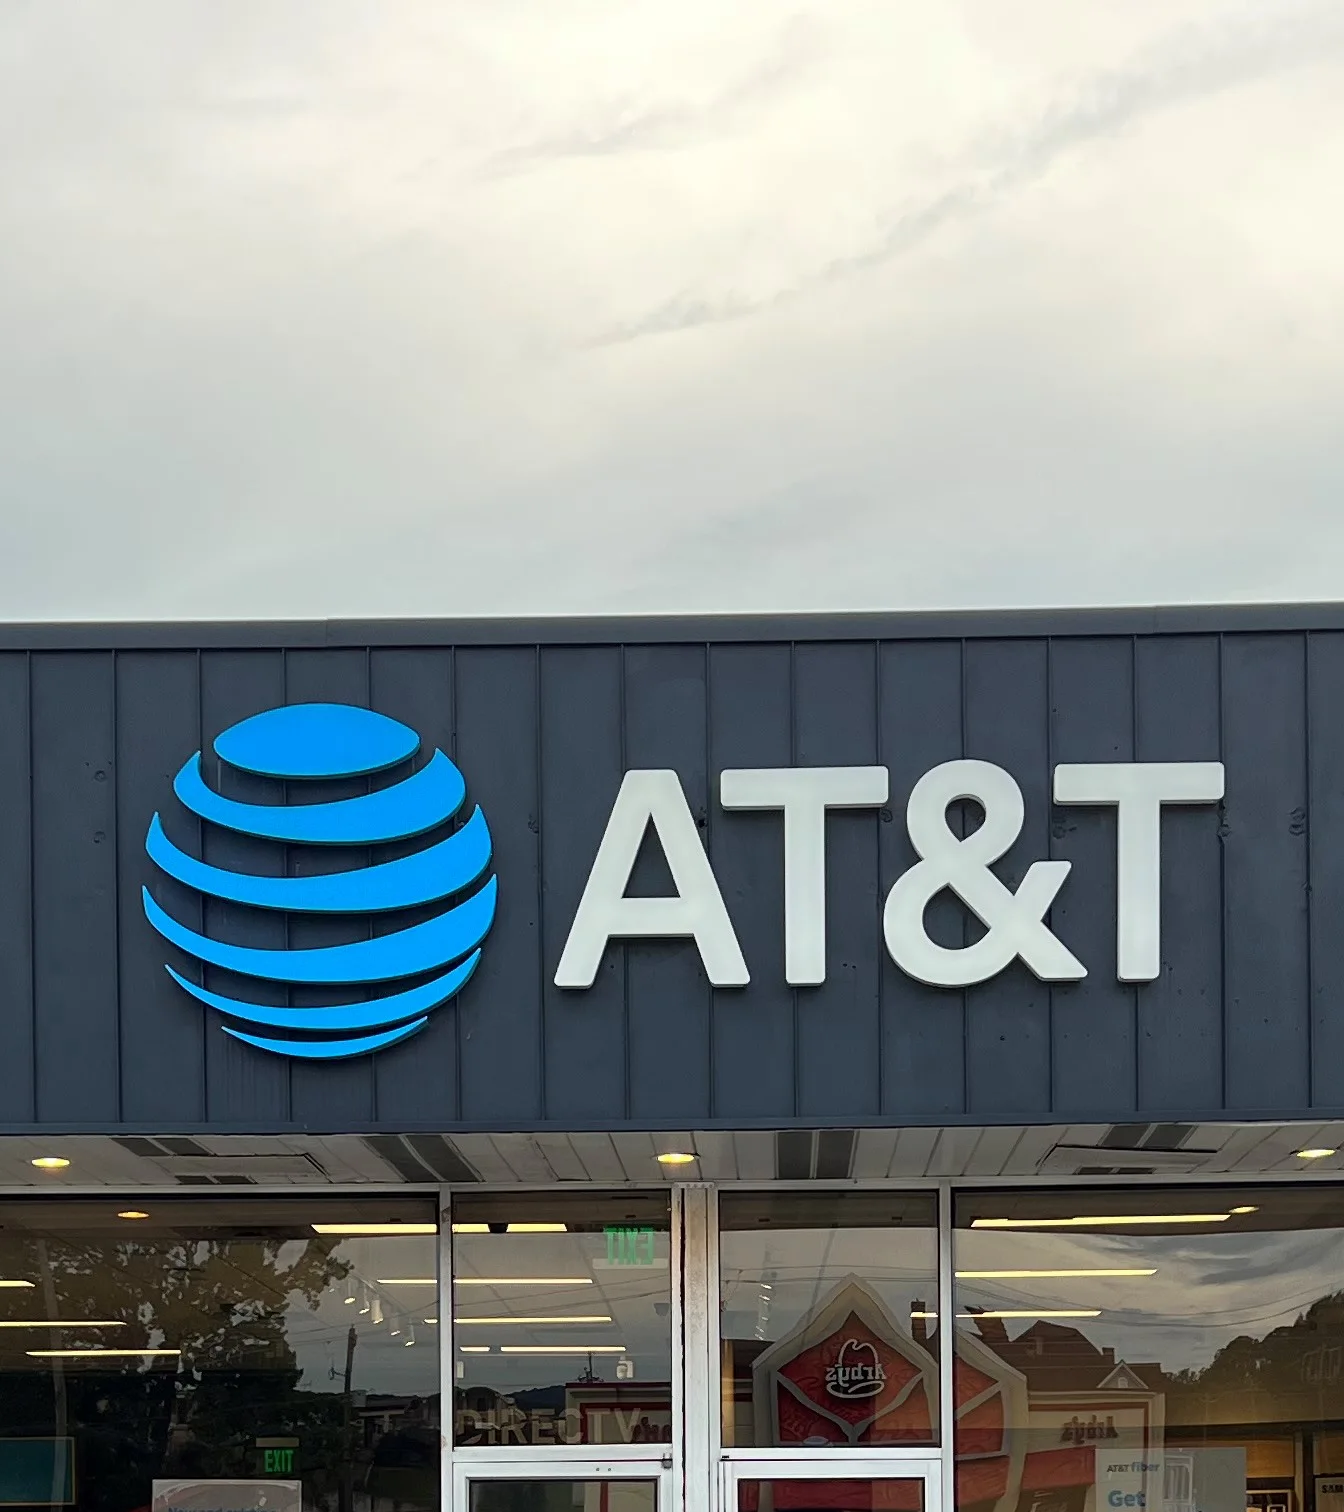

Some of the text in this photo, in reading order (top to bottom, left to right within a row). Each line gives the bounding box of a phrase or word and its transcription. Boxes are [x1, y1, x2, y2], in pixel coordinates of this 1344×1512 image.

[554, 758, 1225, 989] AT&T
[456, 1407, 641, 1445] DIRECTV
[264, 1449, 294, 1473] EXIT
[1107, 1461, 1160, 1473] AT&T fiber
[1108, 1490, 1146, 1507] Get
